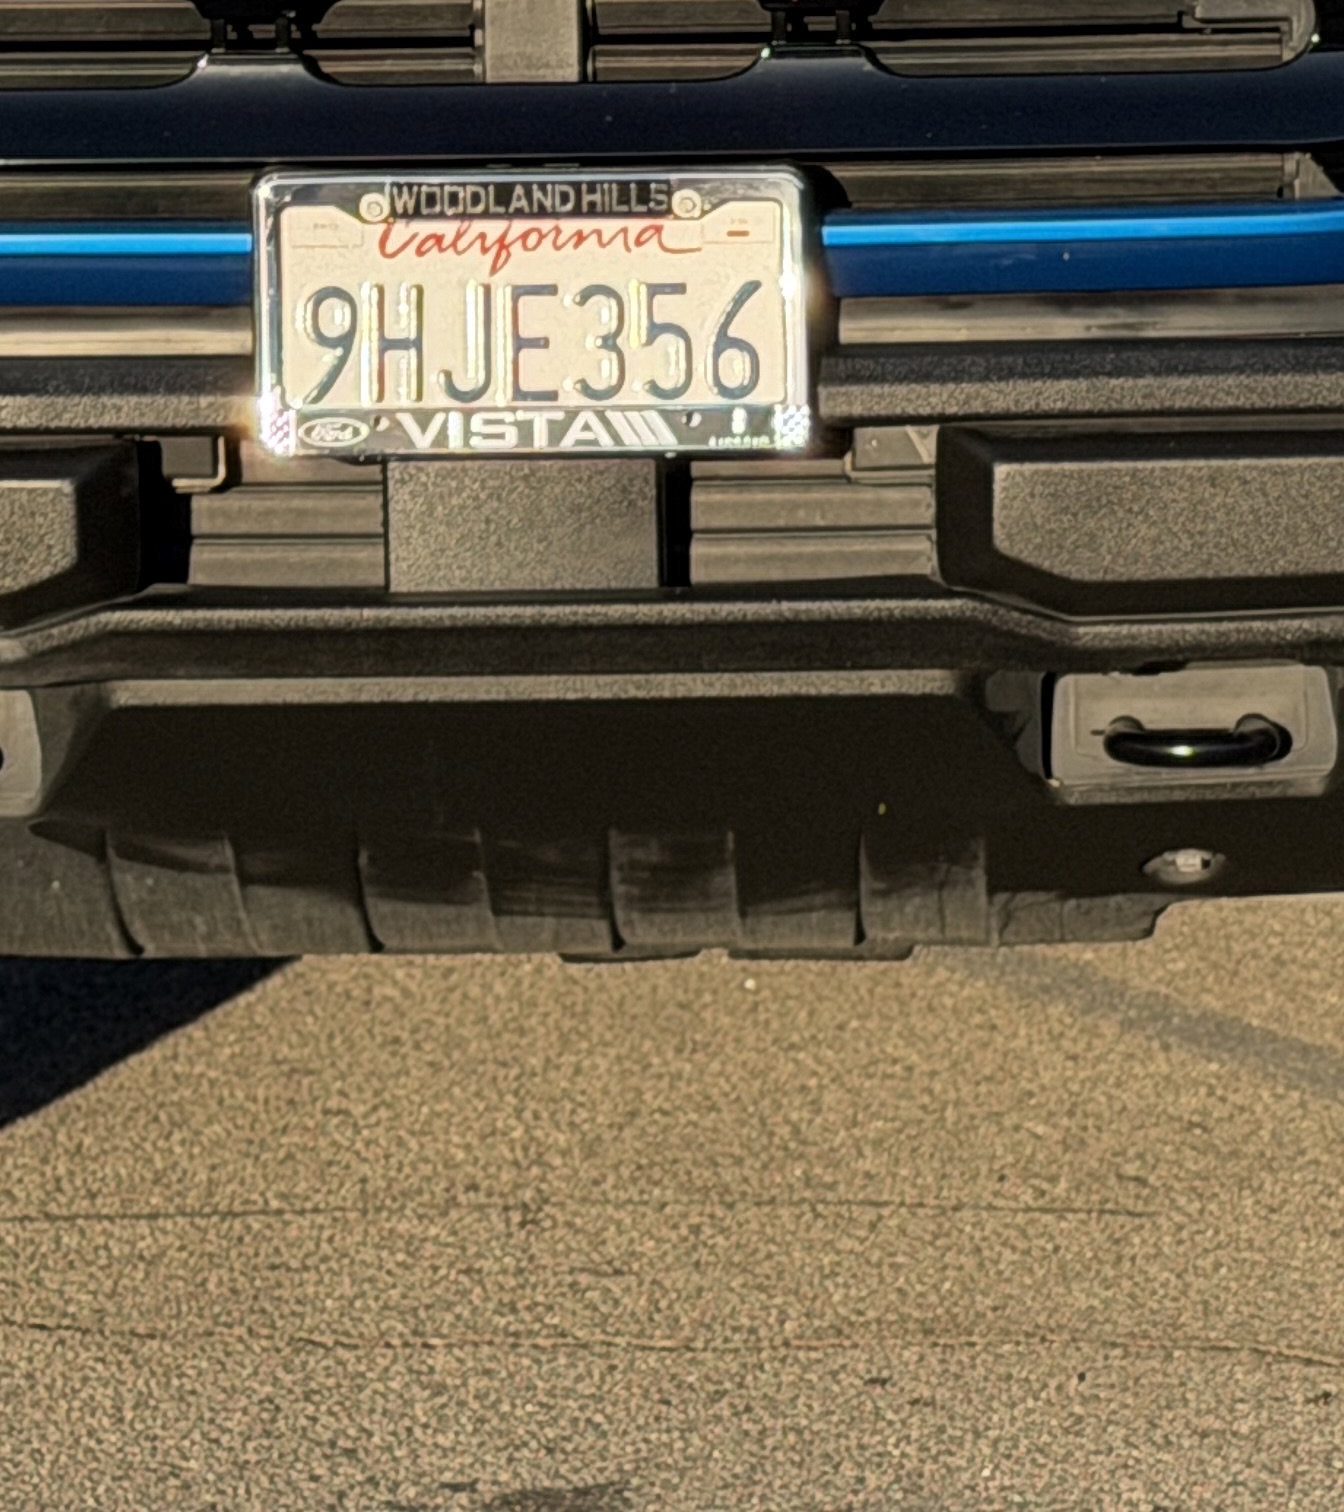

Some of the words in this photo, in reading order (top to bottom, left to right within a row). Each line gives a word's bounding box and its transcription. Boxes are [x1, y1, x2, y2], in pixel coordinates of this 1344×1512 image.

[391, 182, 576, 217] WOODLAND
[580, 181, 670, 214] HILLS
[378, 217, 703, 277] California
[295, 279, 763, 404] 9HJE356
[395, 410, 615, 449] VISTA
